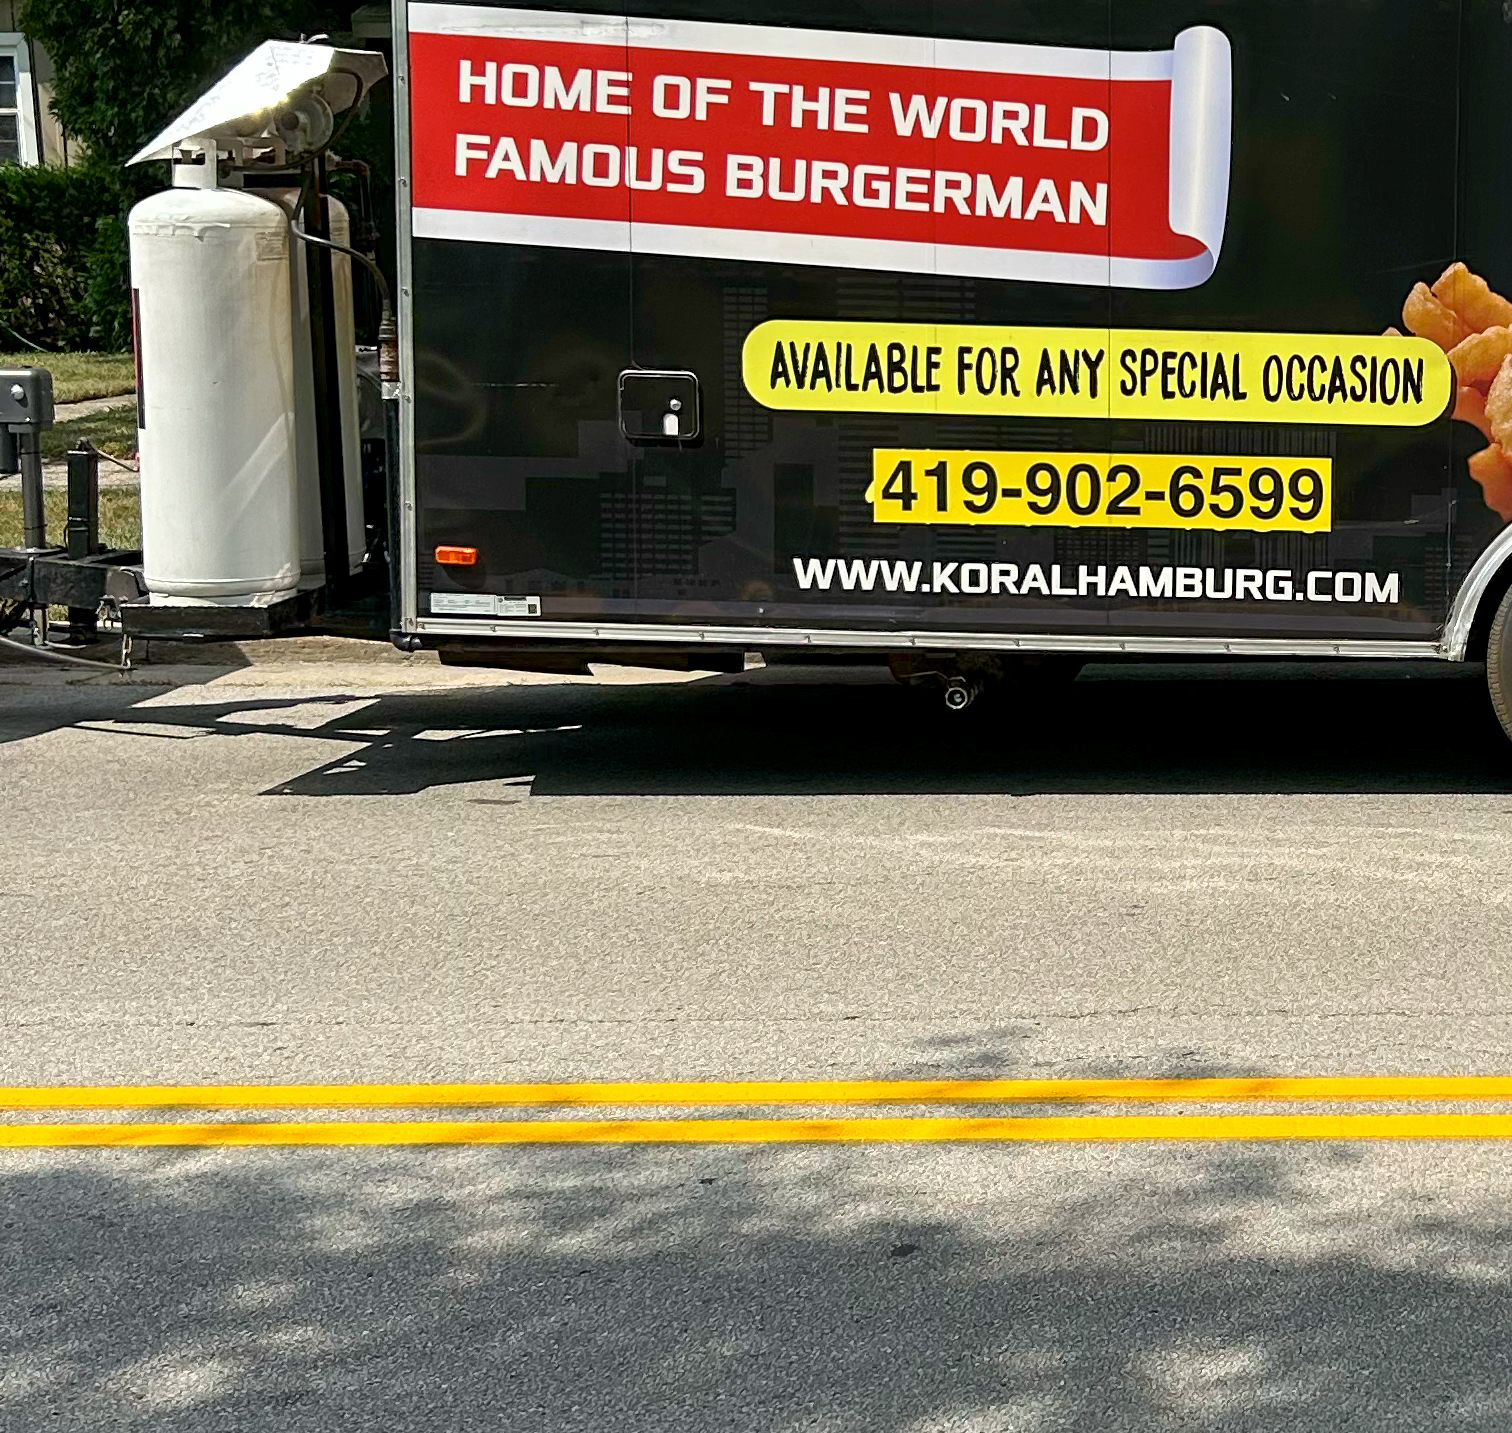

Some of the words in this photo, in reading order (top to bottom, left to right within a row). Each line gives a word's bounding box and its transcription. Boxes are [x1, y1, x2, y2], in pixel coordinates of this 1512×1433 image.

[459, 59, 632, 115] HOME
[653, 75, 731, 121] OF
[750, 82, 869, 133] THE
[889, 93, 1109, 151] WORLD
[456, 134, 704, 194] FAMOUS
[725, 154, 1107, 226] BURGERMAN
[771, 341, 941, 393] AVAILABLE
[958, 346, 1020, 397] FOR
[1036, 348, 1104, 398] ANY
[1120, 348, 1247, 401] SPECIAL
[1263, 355, 1423, 406] OCCASION
[881, 460, 1324, 521] 419-902-6599
[793, 558, 1398, 603] WWW.KORALHAMBURG.COM
